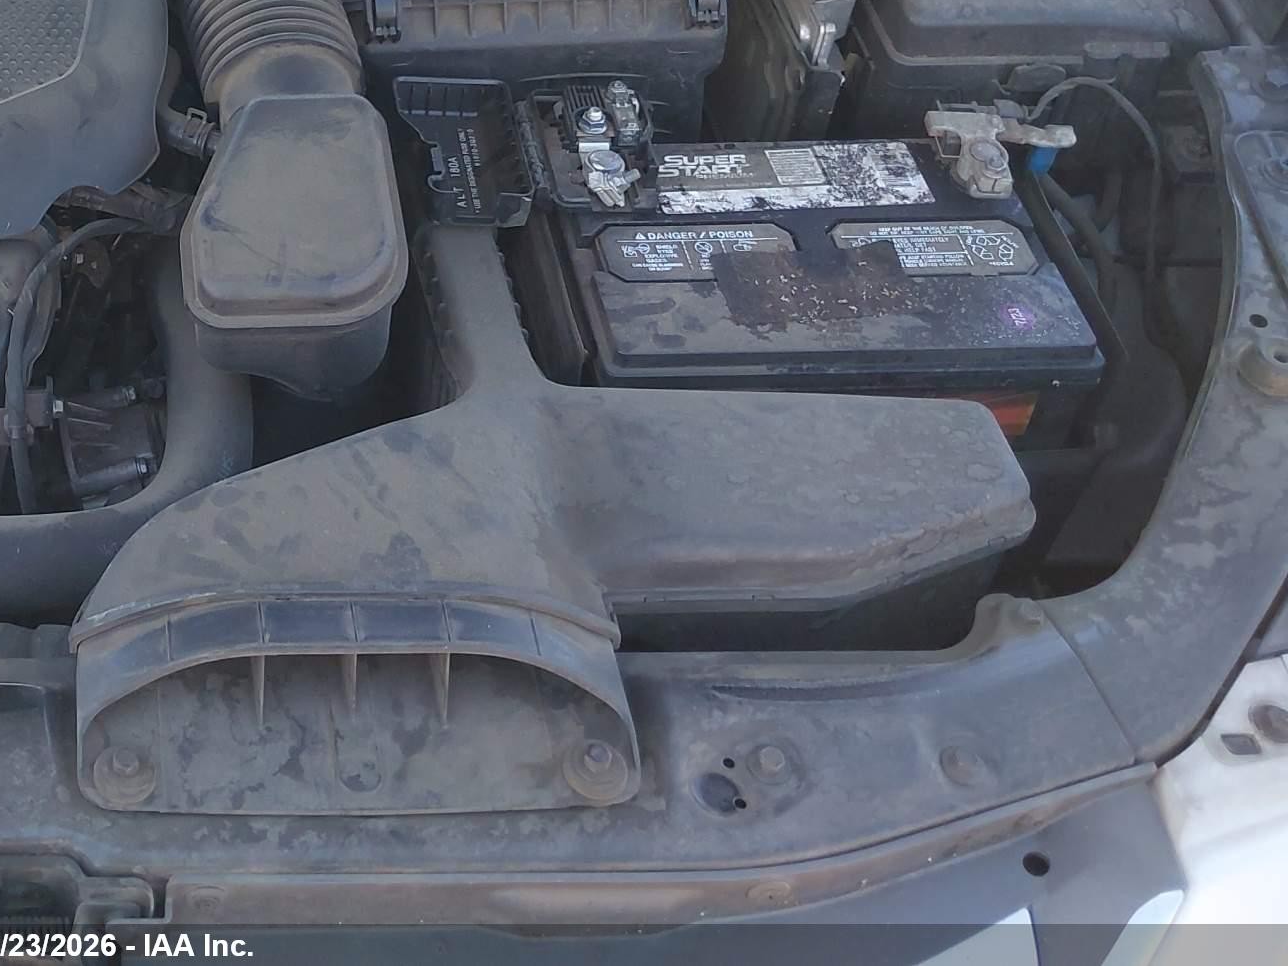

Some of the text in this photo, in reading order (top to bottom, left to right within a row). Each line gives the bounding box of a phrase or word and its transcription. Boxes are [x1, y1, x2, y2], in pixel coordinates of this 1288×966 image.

[664, 154, 747, 166] SUPER
[658, 164, 743, 177] START
[453, 187, 468, 208] ALT
[648, 232, 697, 240] DANGER
[709, 230, 753, 239] POISON
